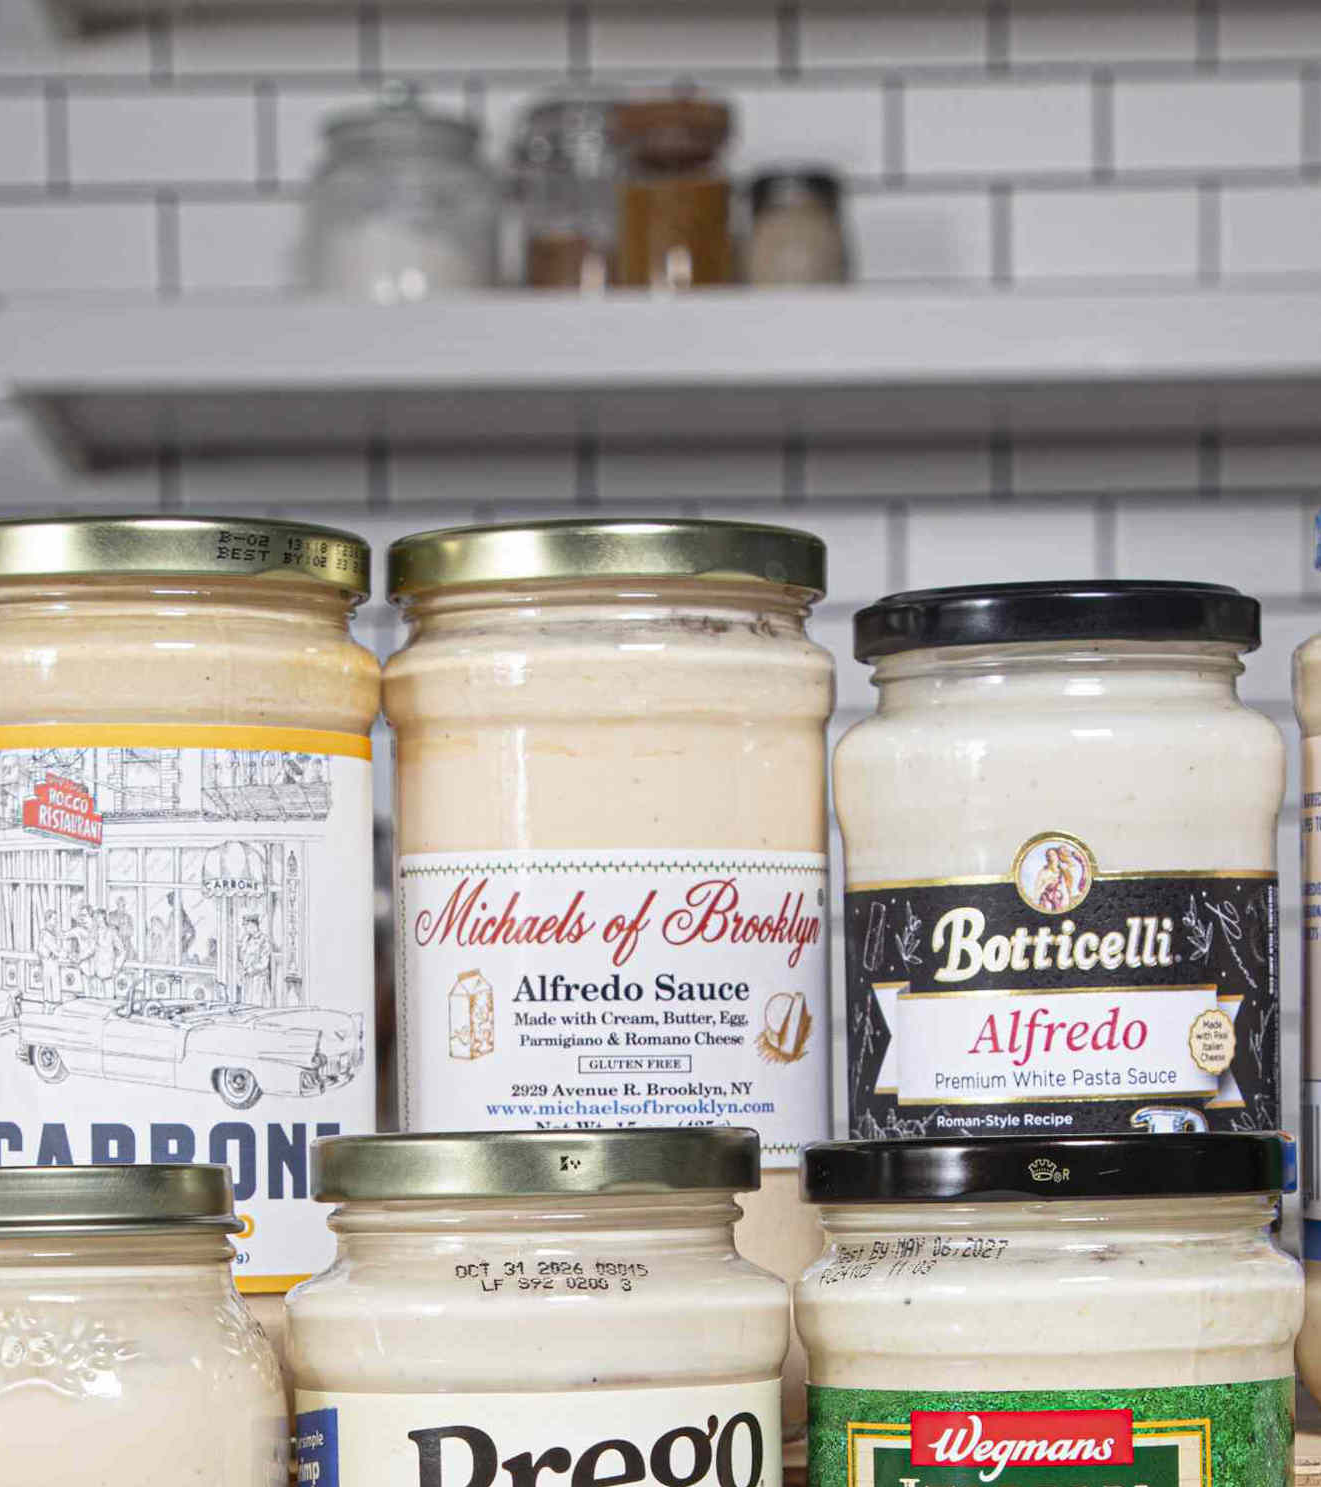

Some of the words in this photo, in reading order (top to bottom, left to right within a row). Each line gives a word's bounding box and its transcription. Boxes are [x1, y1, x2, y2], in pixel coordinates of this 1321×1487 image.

[49, 789, 88, 813] ROCCO
[415, 876, 597, 947] Michaels
[603, 889, 657, 966] of
[662, 877, 820, 968] Brooklyn
[932, 907, 1174, 982] Botticelli
[513, 975, 643, 1001] Alfredo
[655, 975, 750, 1001] Sauce
[515, 1012, 556, 1026] Made
[561, 1012, 597, 1026] with
[601, 1012, 659, 1027] Cream,
[664, 1011, 716, 1027] Butter,
[519, 1033, 602, 1048] Parmigiano
[607, 1034, 620, 1046] &
[626, 1033, 690, 1046] Romano
[695, 1033, 743, 1046] Cheese
[968, 1007, 1147, 1065] Alfredo
[590, 1059, 643, 1070] GLUTEN
[647, 1059, 681, 1069] FREE
[511, 1084, 547, 1097] 2929
[552, 1085, 619, 1097] Avenue
[624, 1084, 640, 1096] R.
[647, 1083, 727, 1098] Brooklyn,
[731, 1082, 752, 1096] NY
[935, 1071, 1006, 1090] Premium
[1013, 1070, 1067, 1089] White
[1073, 1070, 1120, 1087] Pasta
[1128, 1068, 1176, 1085] Sauce
[486, 1100, 774, 1116] www.michaelsofbrooklyn.com
[928, 1414, 1114, 1482] Wegmans
